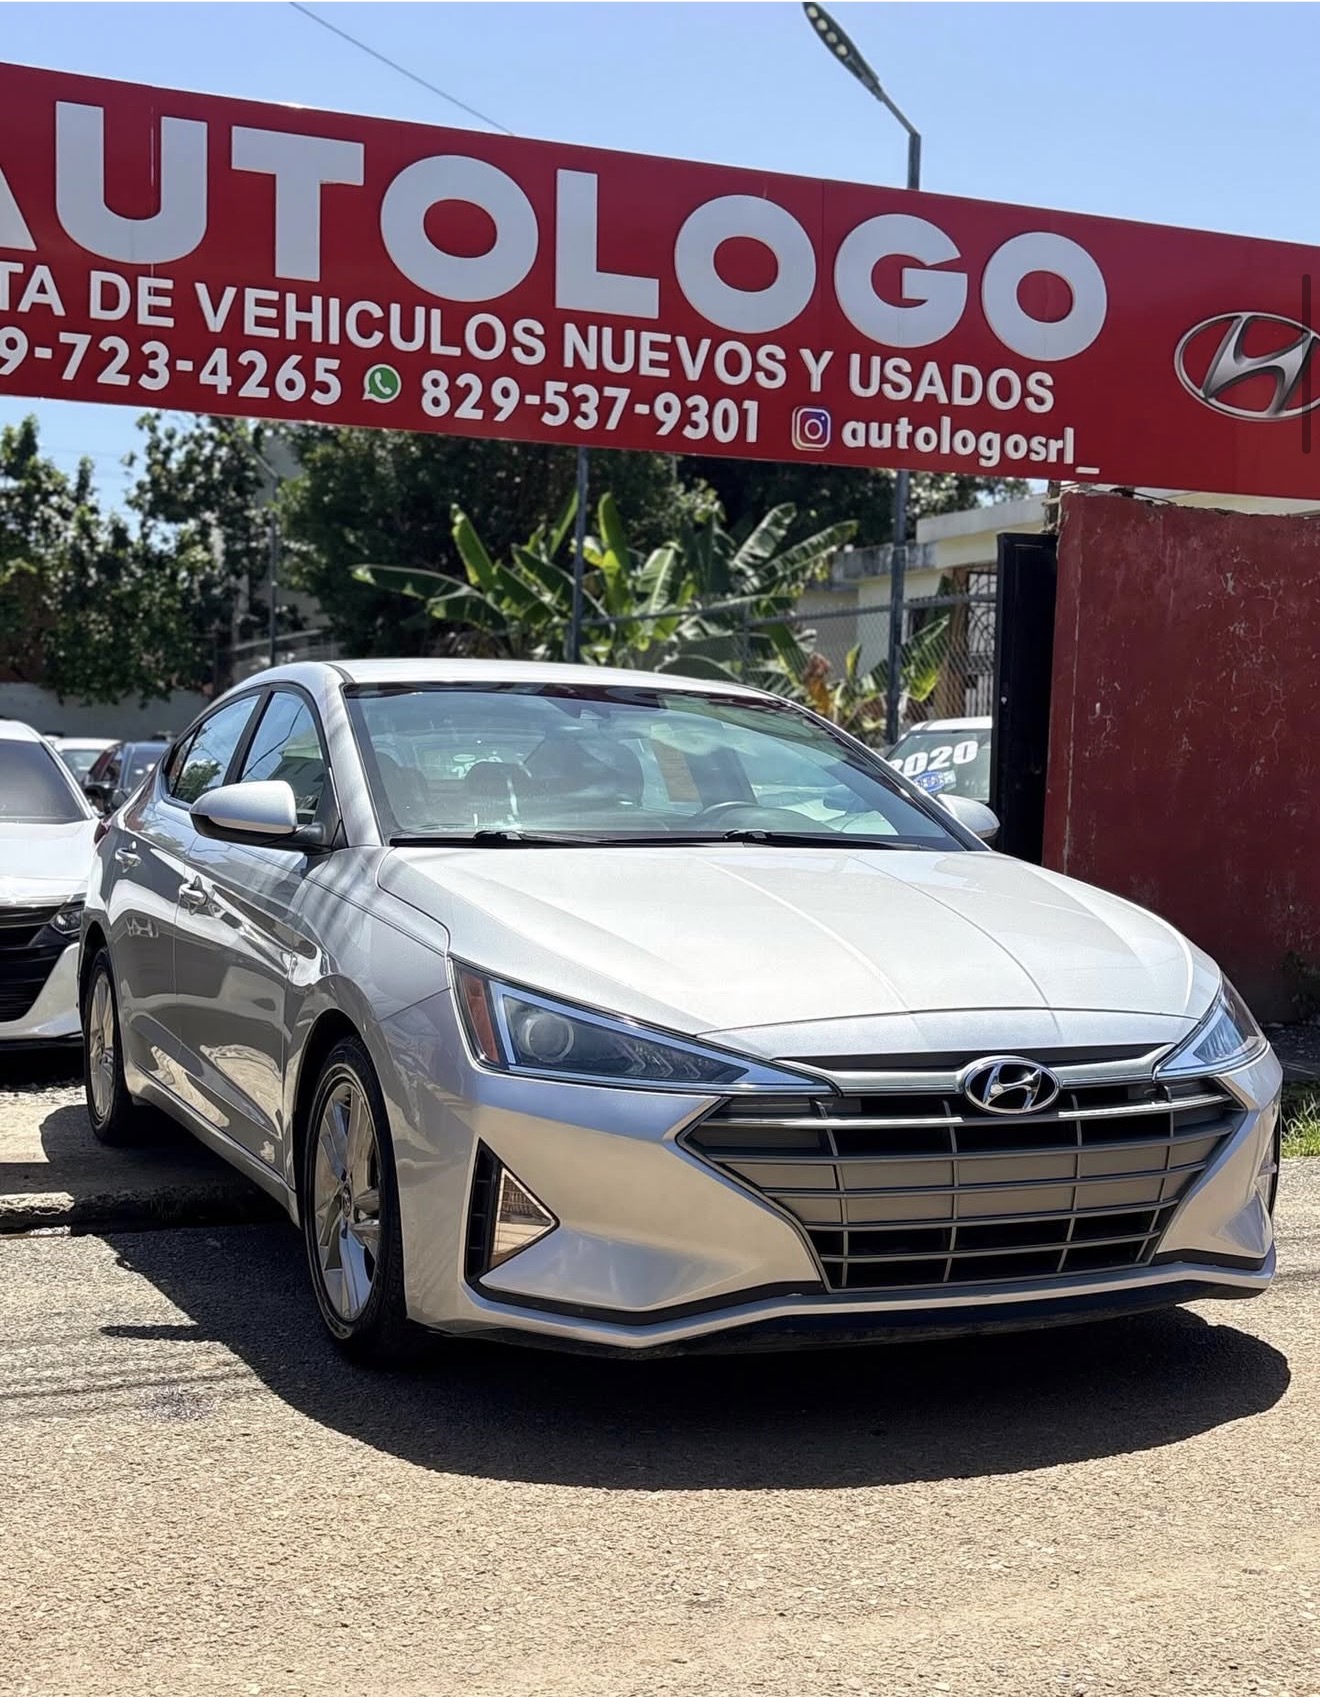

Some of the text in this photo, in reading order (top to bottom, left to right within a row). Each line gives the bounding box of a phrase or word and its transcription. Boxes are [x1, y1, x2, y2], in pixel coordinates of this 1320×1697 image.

[0, 101, 1107, 362] UTOLOGO
[0, 326, 1100, 475] 9-723-4265 829-537-9301 autologosrl_
[89, 270, 175, 328] DE
[195, 282, 546, 366] VEHICULOS
[563, 322, 786, 389] NUEVOS
[799, 348, 834, 392] Y
[849, 353, 1054, 413] USADOS
